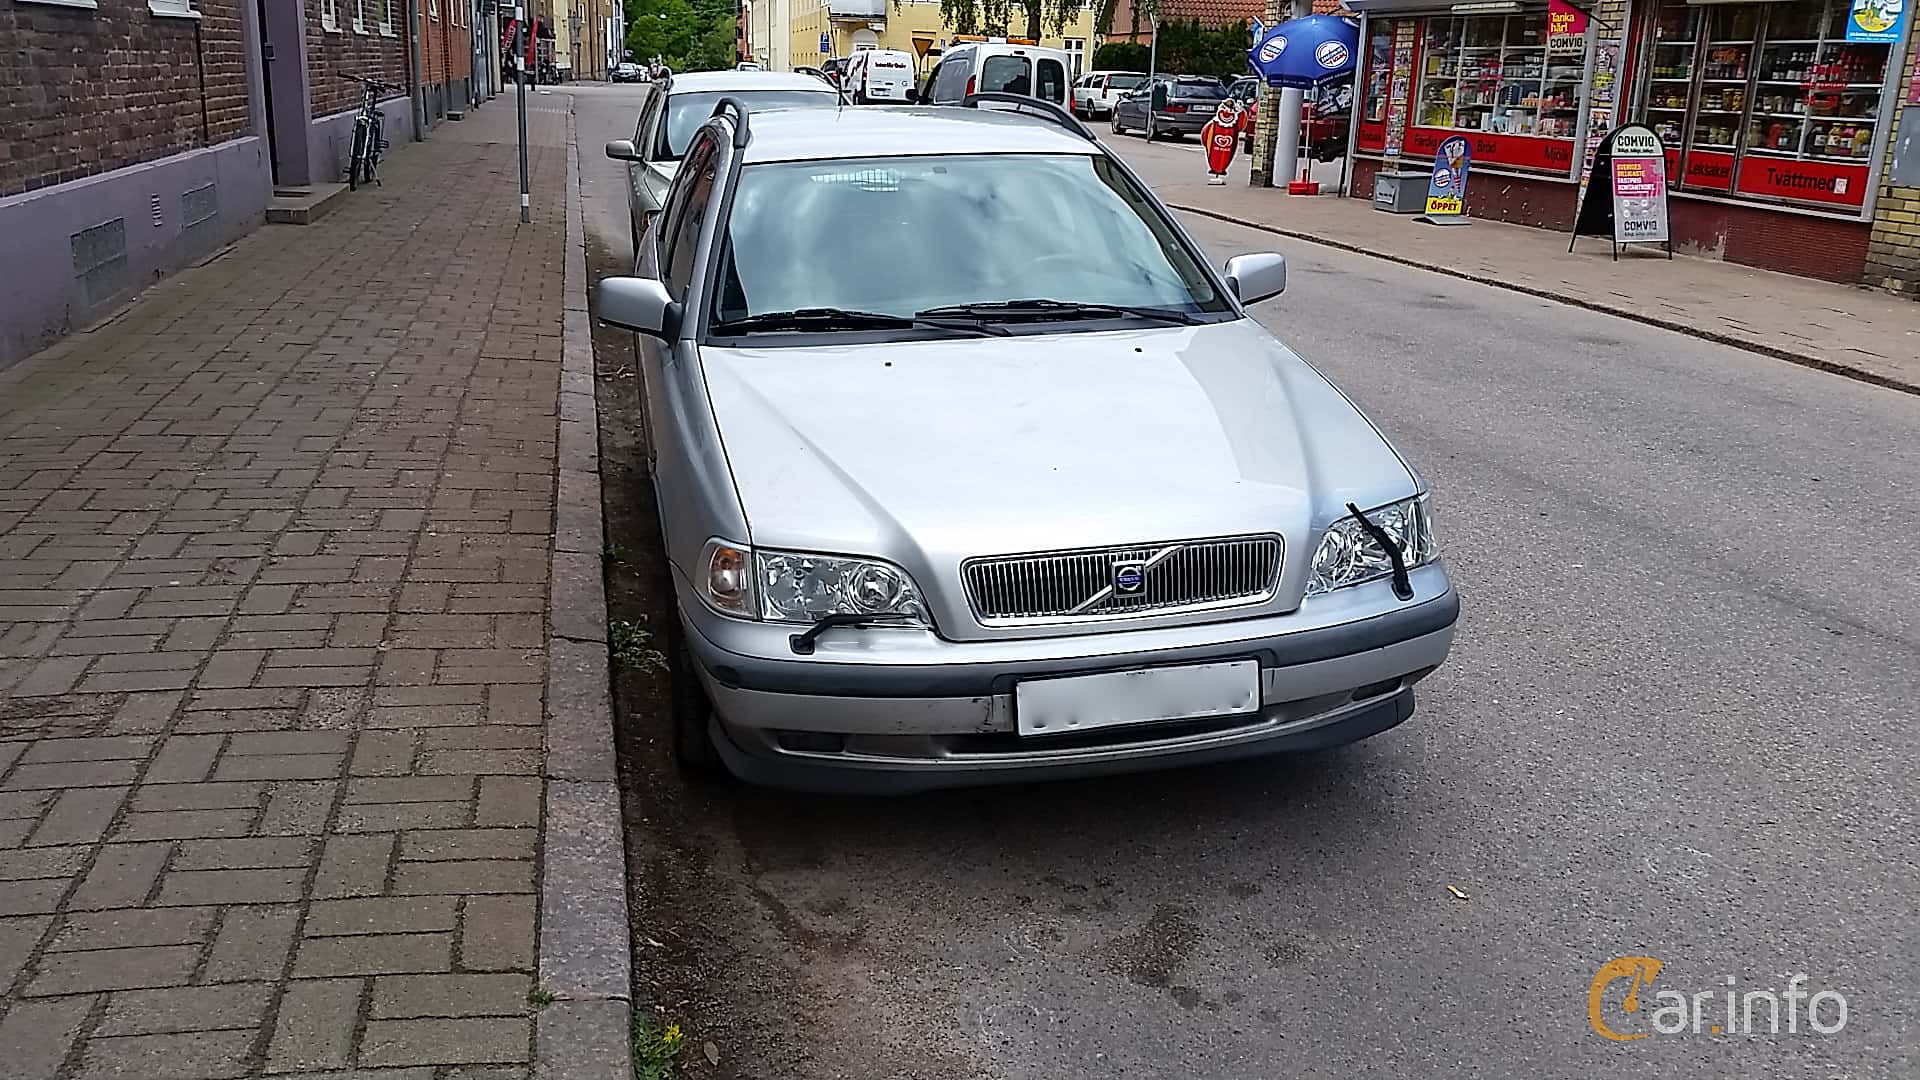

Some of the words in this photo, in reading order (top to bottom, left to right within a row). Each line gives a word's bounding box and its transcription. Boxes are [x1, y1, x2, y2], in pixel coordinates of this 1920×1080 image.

[1550, 37, 1583, 48] COMVIQ
[1617, 135, 1655, 147] COMVIQ
[1688, 159, 1730, 179] Leksaker
[1767, 168, 1850, 193] Tvättmedl
[1430, 200, 1458, 211] ÖPPET
[1624, 220, 1657, 231] COMVIQ
